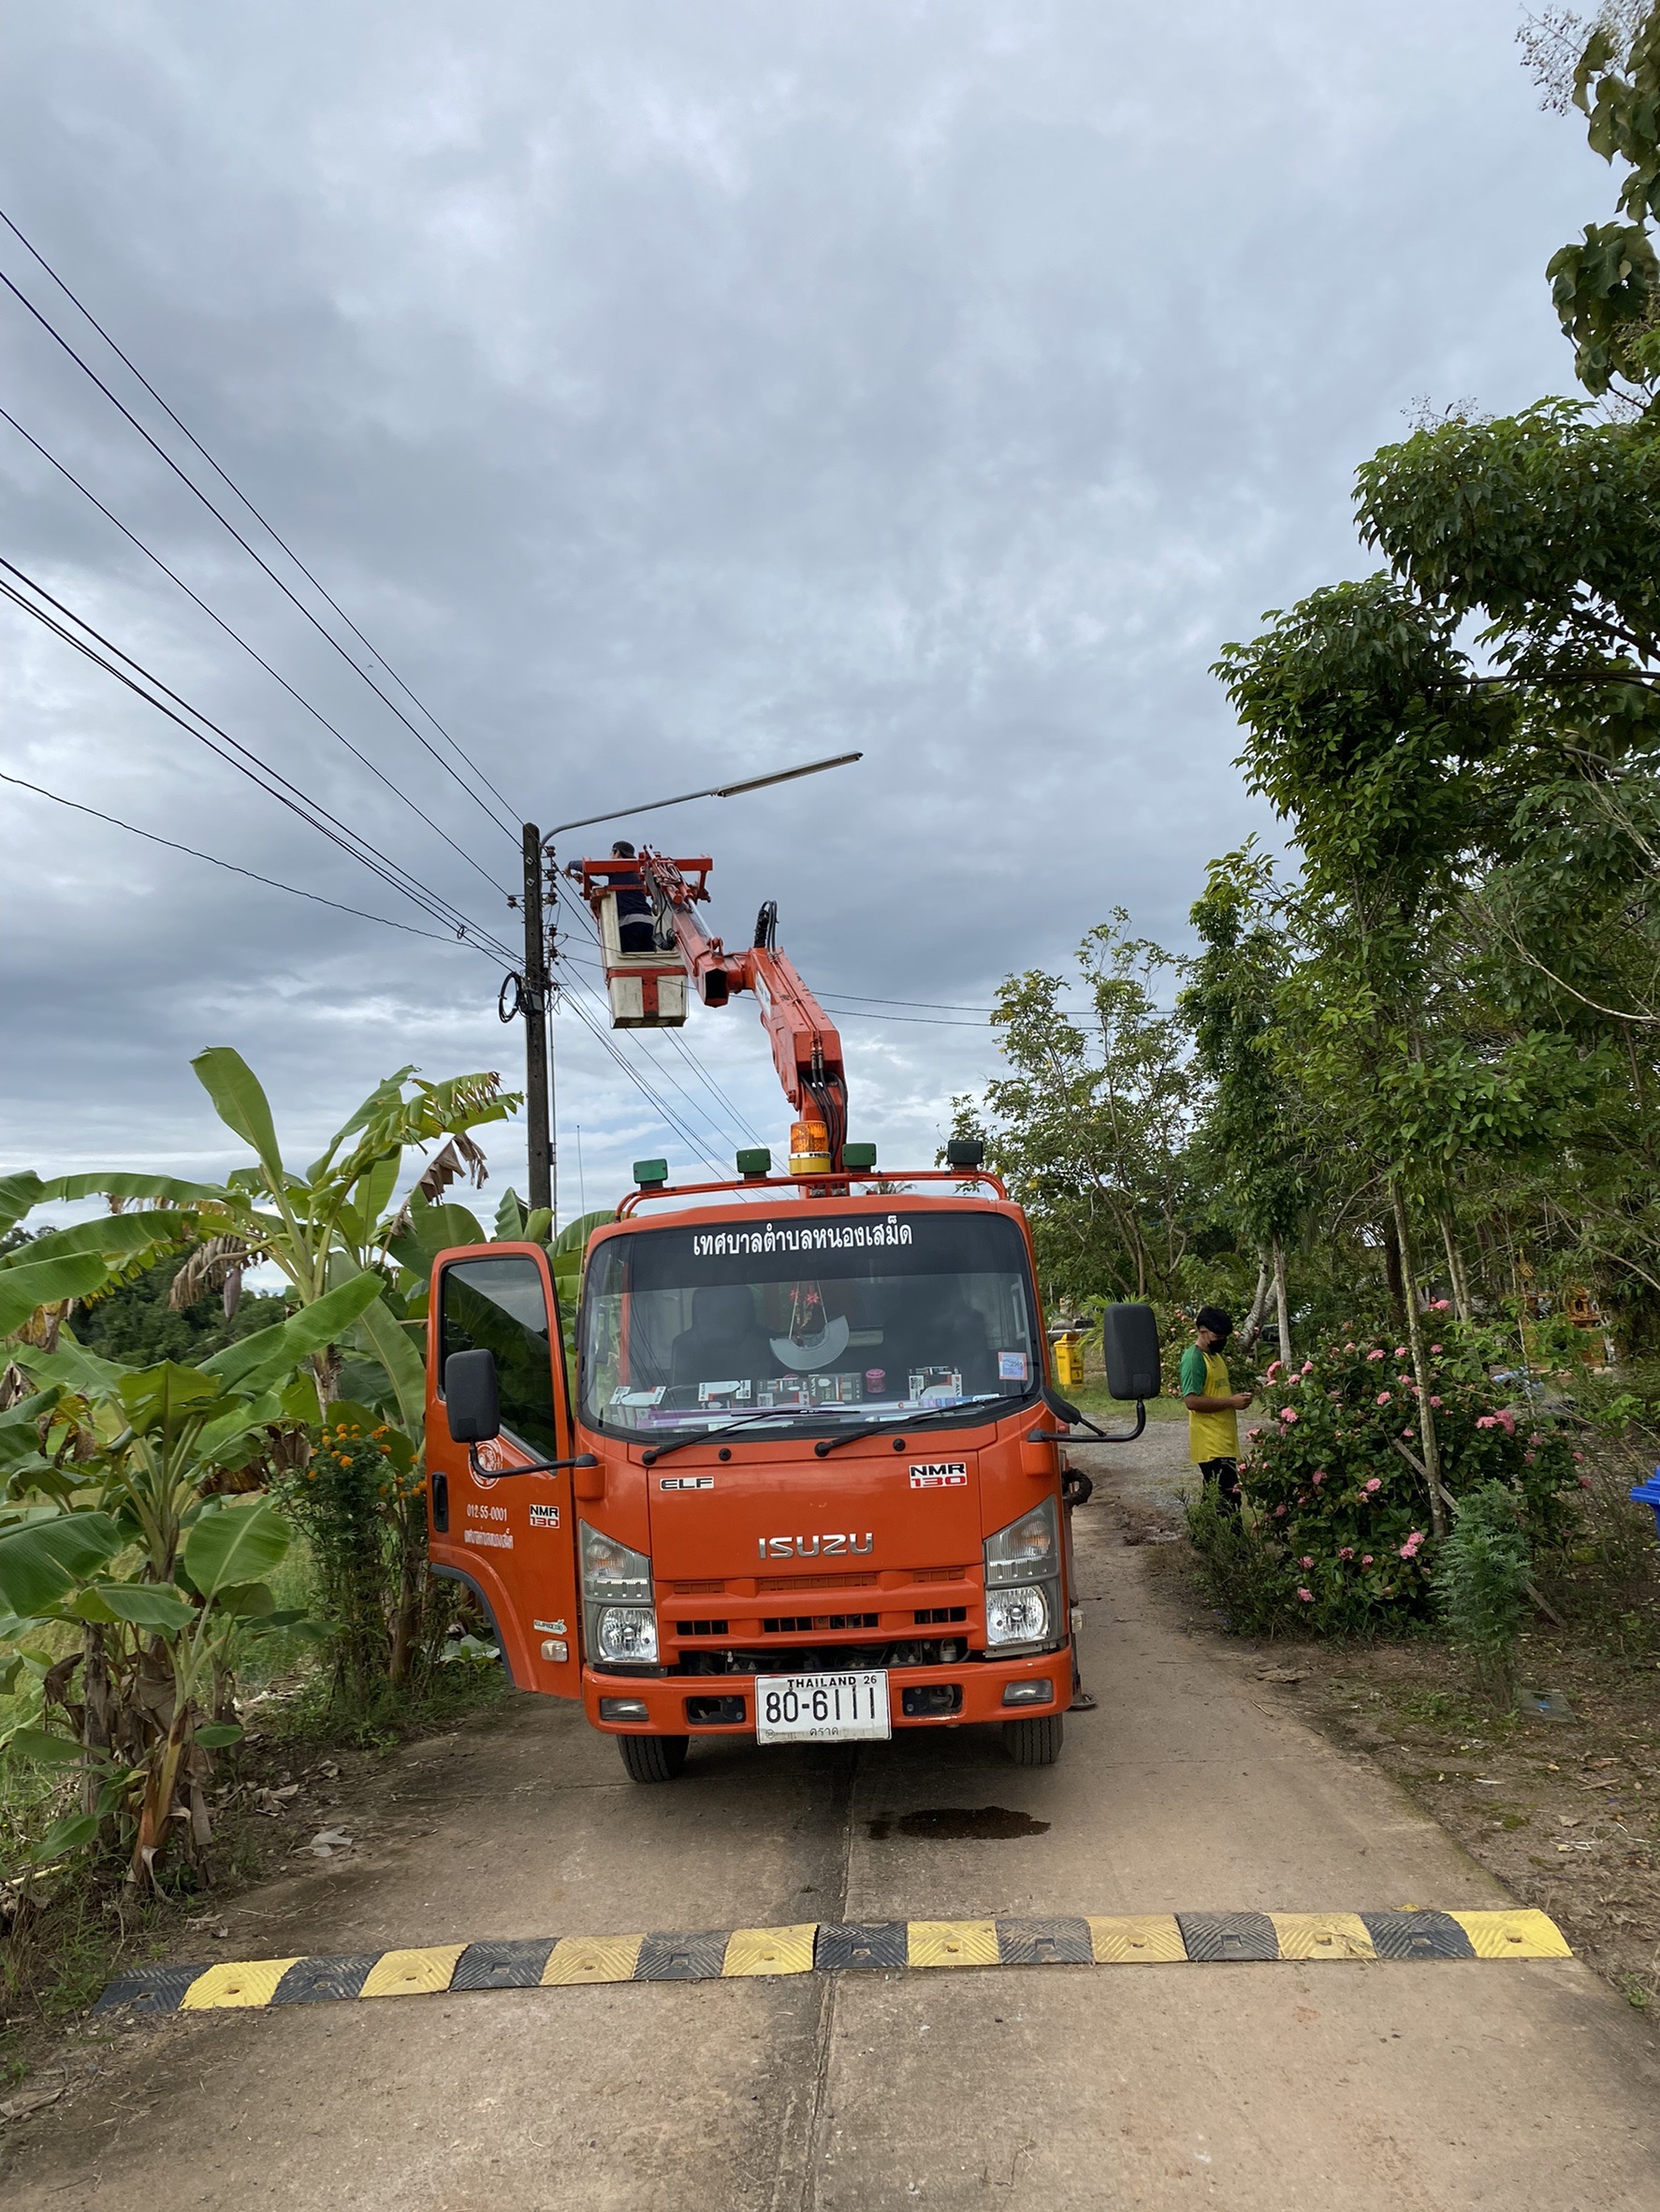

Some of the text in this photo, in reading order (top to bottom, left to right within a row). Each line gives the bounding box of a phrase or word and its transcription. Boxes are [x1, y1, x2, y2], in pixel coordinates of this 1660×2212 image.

[693, 1215, 913, 1256] เทศบาลตำบลหนองเสม็ด
[910, 1463, 966, 1477] NMR
[661, 1477, 713, 1491] ELF
[910, 1476, 967, 1489] 130
[466, 1503, 507, 1522] 012-55-0001
[530, 1505, 559, 1518] NMR
[530, 1517, 560, 1527] 130
[758, 1532, 875, 1560] ISUZU
[787, 1675, 878, 1689] THAILAND 26
[765, 1687, 875, 1724] 80-6111
